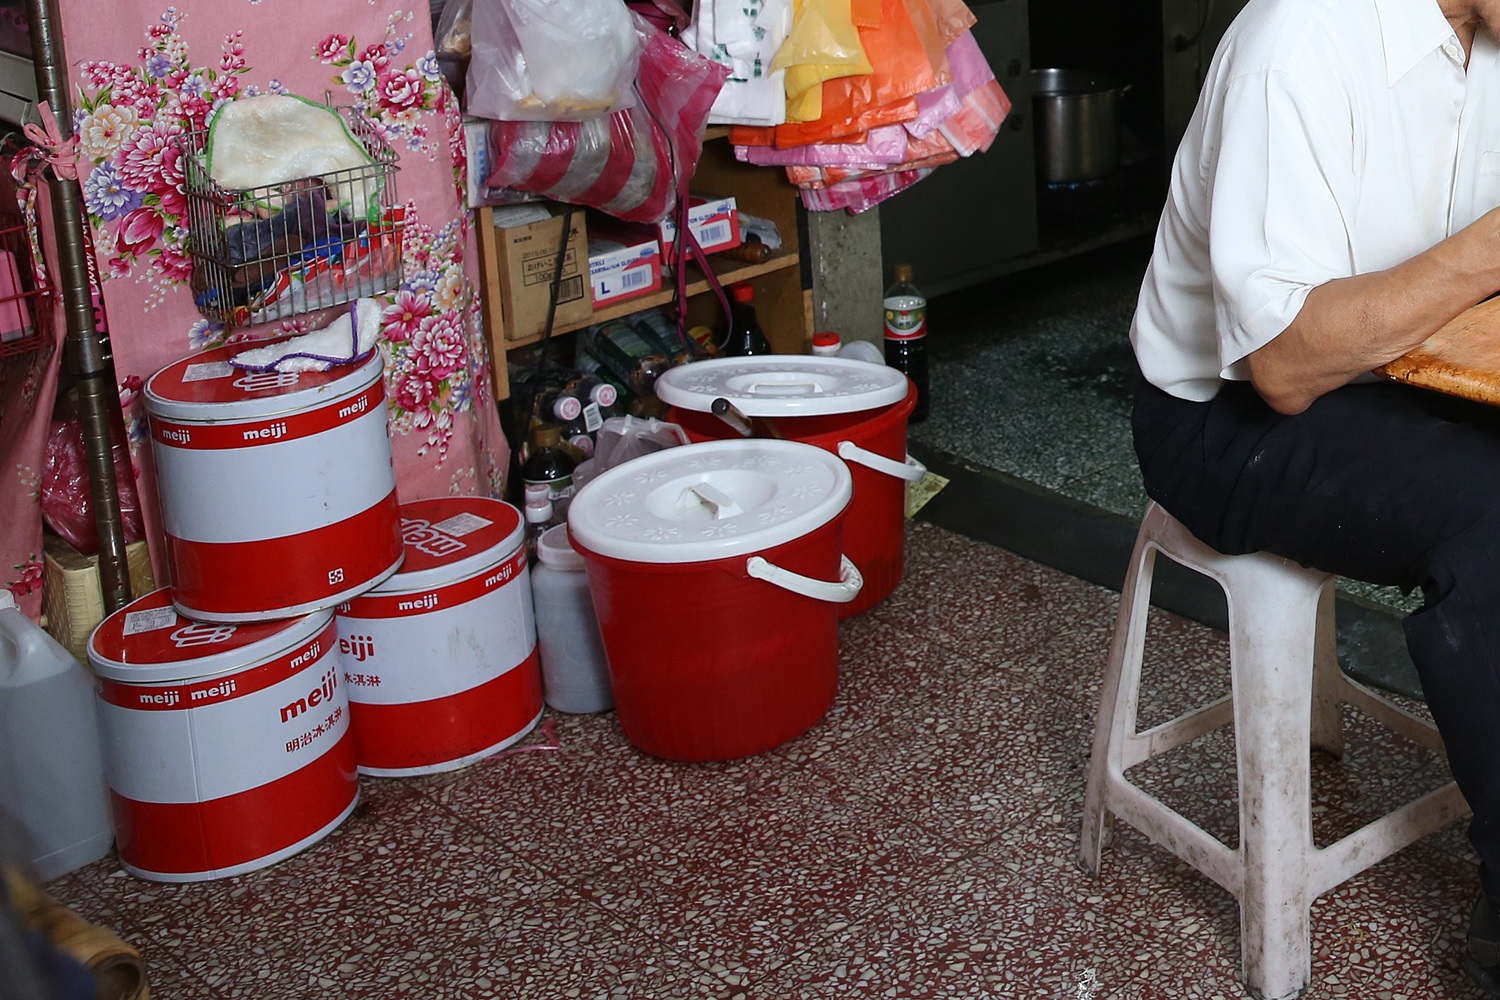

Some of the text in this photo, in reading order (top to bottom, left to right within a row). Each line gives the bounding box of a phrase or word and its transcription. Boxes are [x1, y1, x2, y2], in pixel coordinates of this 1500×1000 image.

[601, 282, 610, 296] L
[162, 395, 369, 444] meiji meiji meiji
[398, 593, 439, 611] meiji
[485, 564, 513, 587] meiji
[340, 634, 375, 662] eiji
[139, 641, 321, 705] meiji meiji meiji
[280, 667, 338, 723] meiji
[285, 706, 343, 753] 明治冰淇淋
